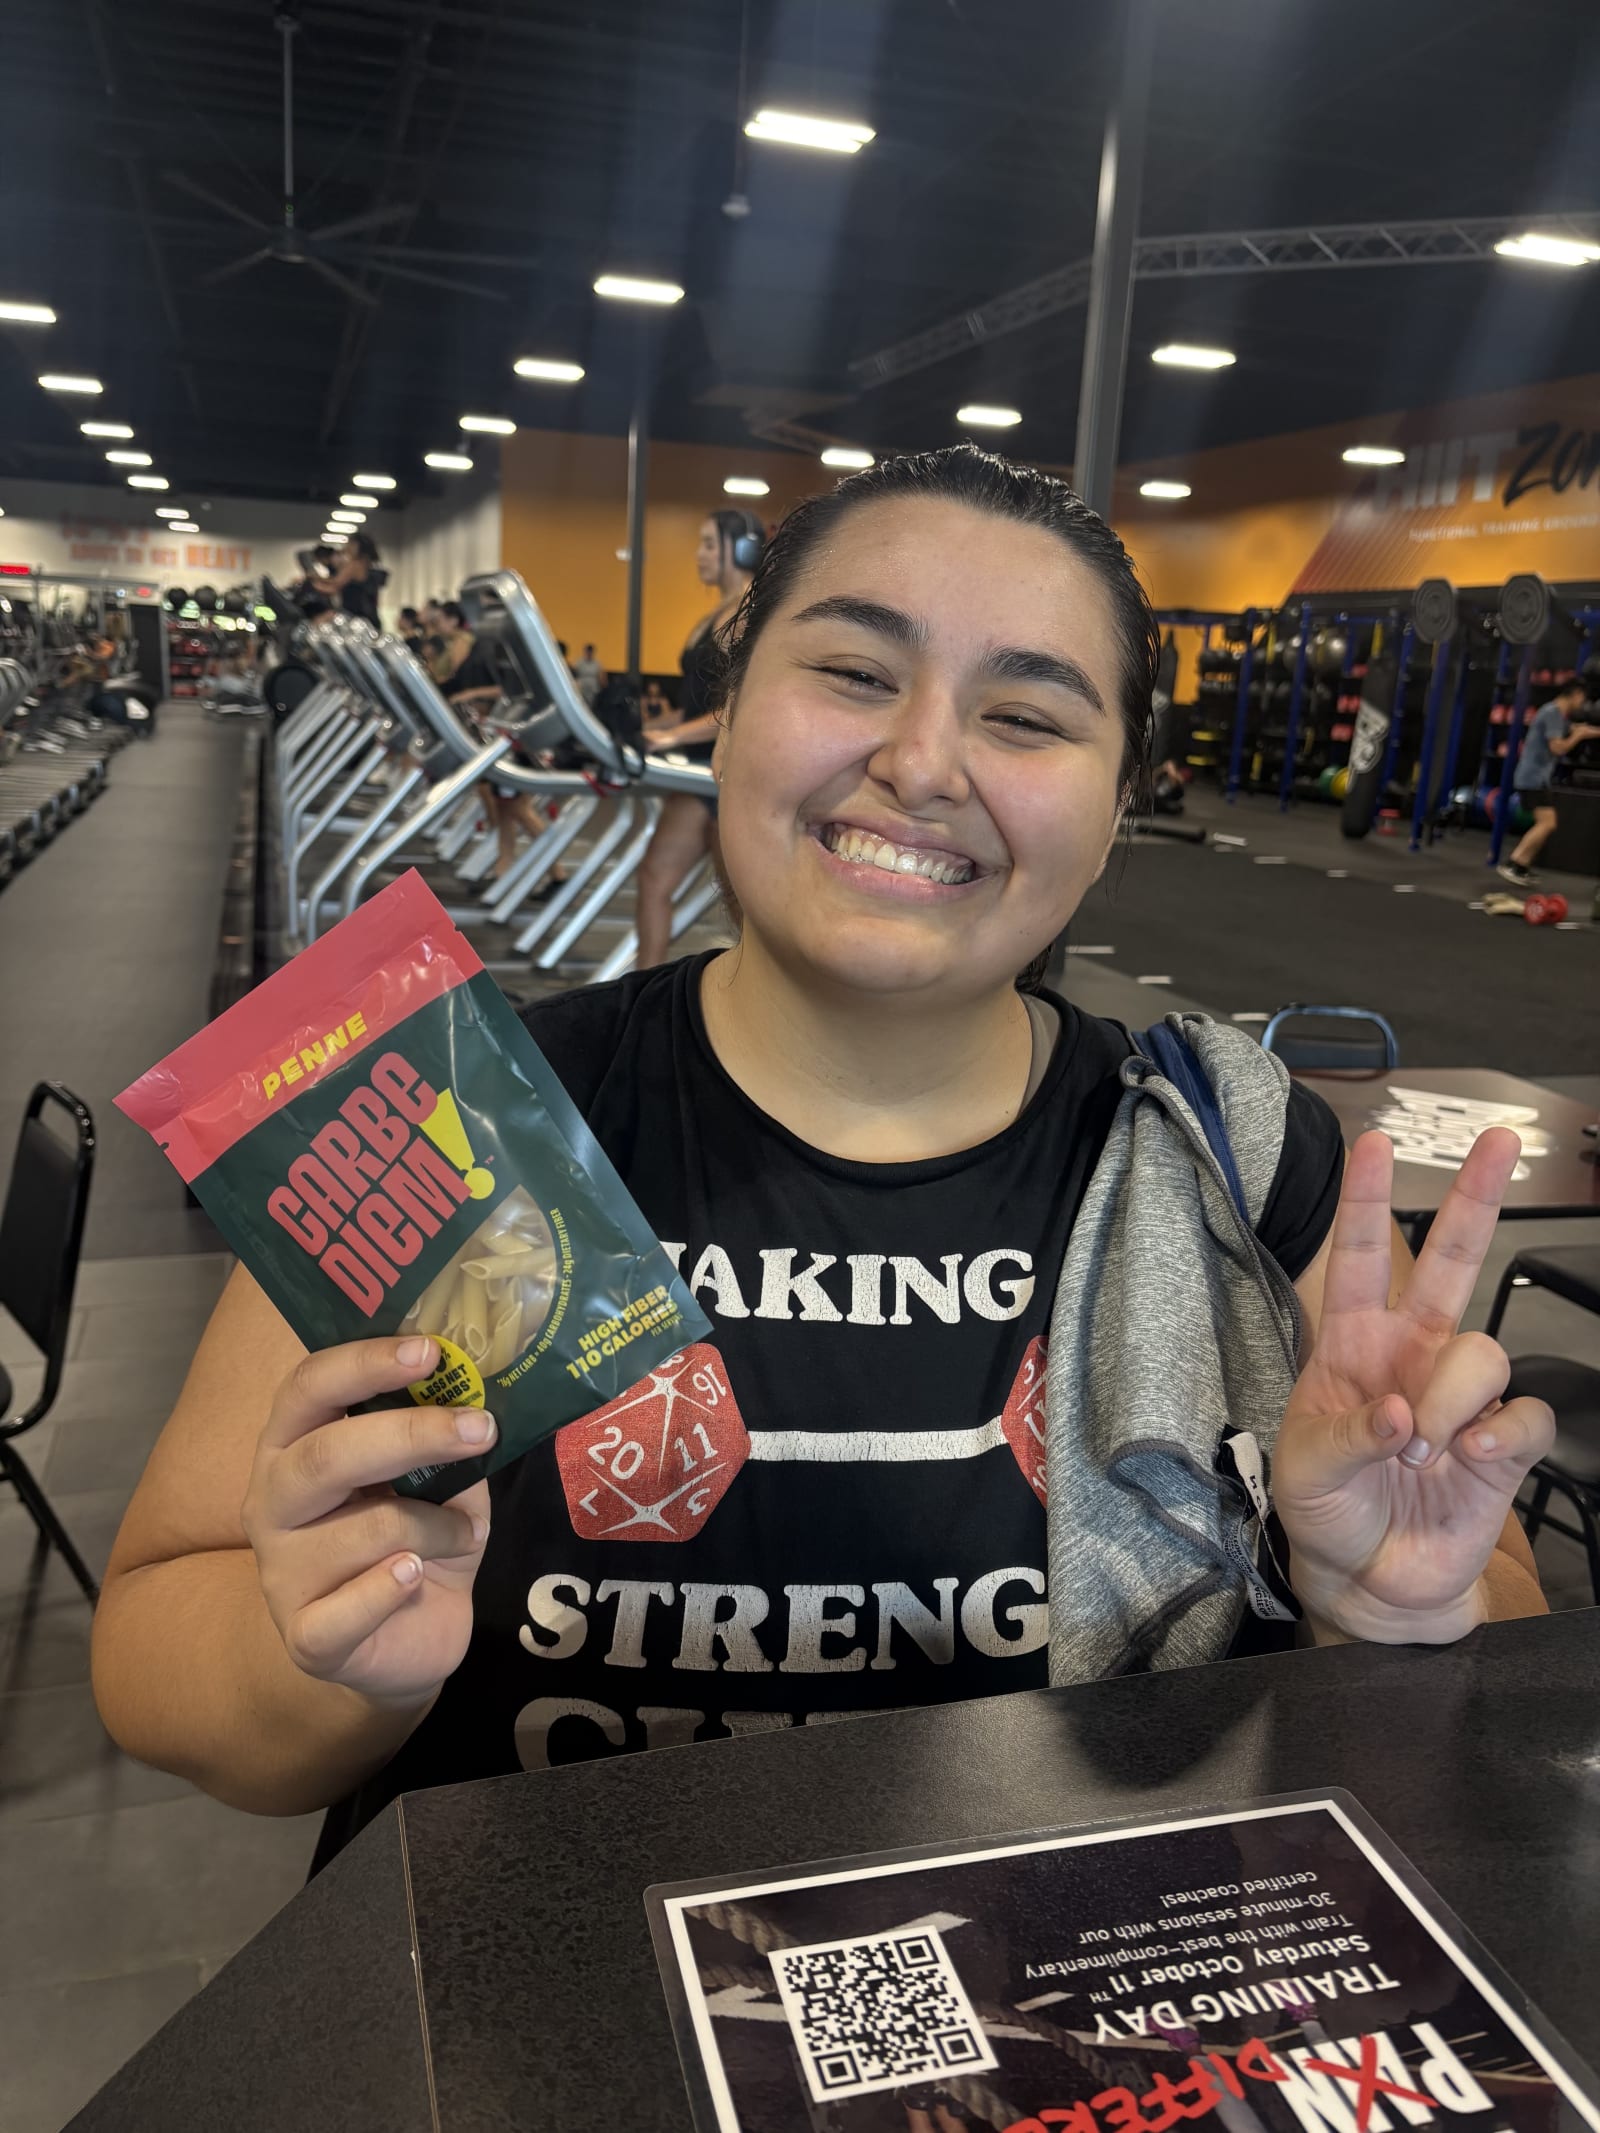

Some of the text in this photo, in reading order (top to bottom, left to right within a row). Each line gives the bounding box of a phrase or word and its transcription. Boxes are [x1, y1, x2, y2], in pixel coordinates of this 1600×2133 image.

[262, 1011, 368, 1100] PENNE
[550, 1208, 566, 1230] FIBER
[559, 1229, 571, 1259] DIETARY
[563, 1259, 575, 1274] 24g
[659, 1240, 1036, 1325] AKING
[546, 1279, 572, 1345] CARBOHYDRATES
[578, 1285, 669, 1351] HIGH FIBER
[566, 1298, 678, 1379] 110 CALORIES
[418, 1378, 447, 1400] LESS
[445, 1364, 468, 1385] NET
[520, 1354, 537, 1375] CARB
[588, 1425, 645, 1480] 20
[674, 1423, 719, 1473] 11
[519, 1567, 1049, 1673] STRENG
[1160, 1871, 1317, 1909] certified coaches!
[1079, 1891, 1336, 1945] 30-minute sessions with our
[1226, 1926, 1255, 1945] the
[1257, 1918, 1300, 1939] with
[1302, 1913, 1353, 1930] Train
[1255, 1933, 1371, 1968] Saturday
[1141, 1955, 1244, 1987] October
[1092, 1963, 1401, 2045] TRAINING DAY
